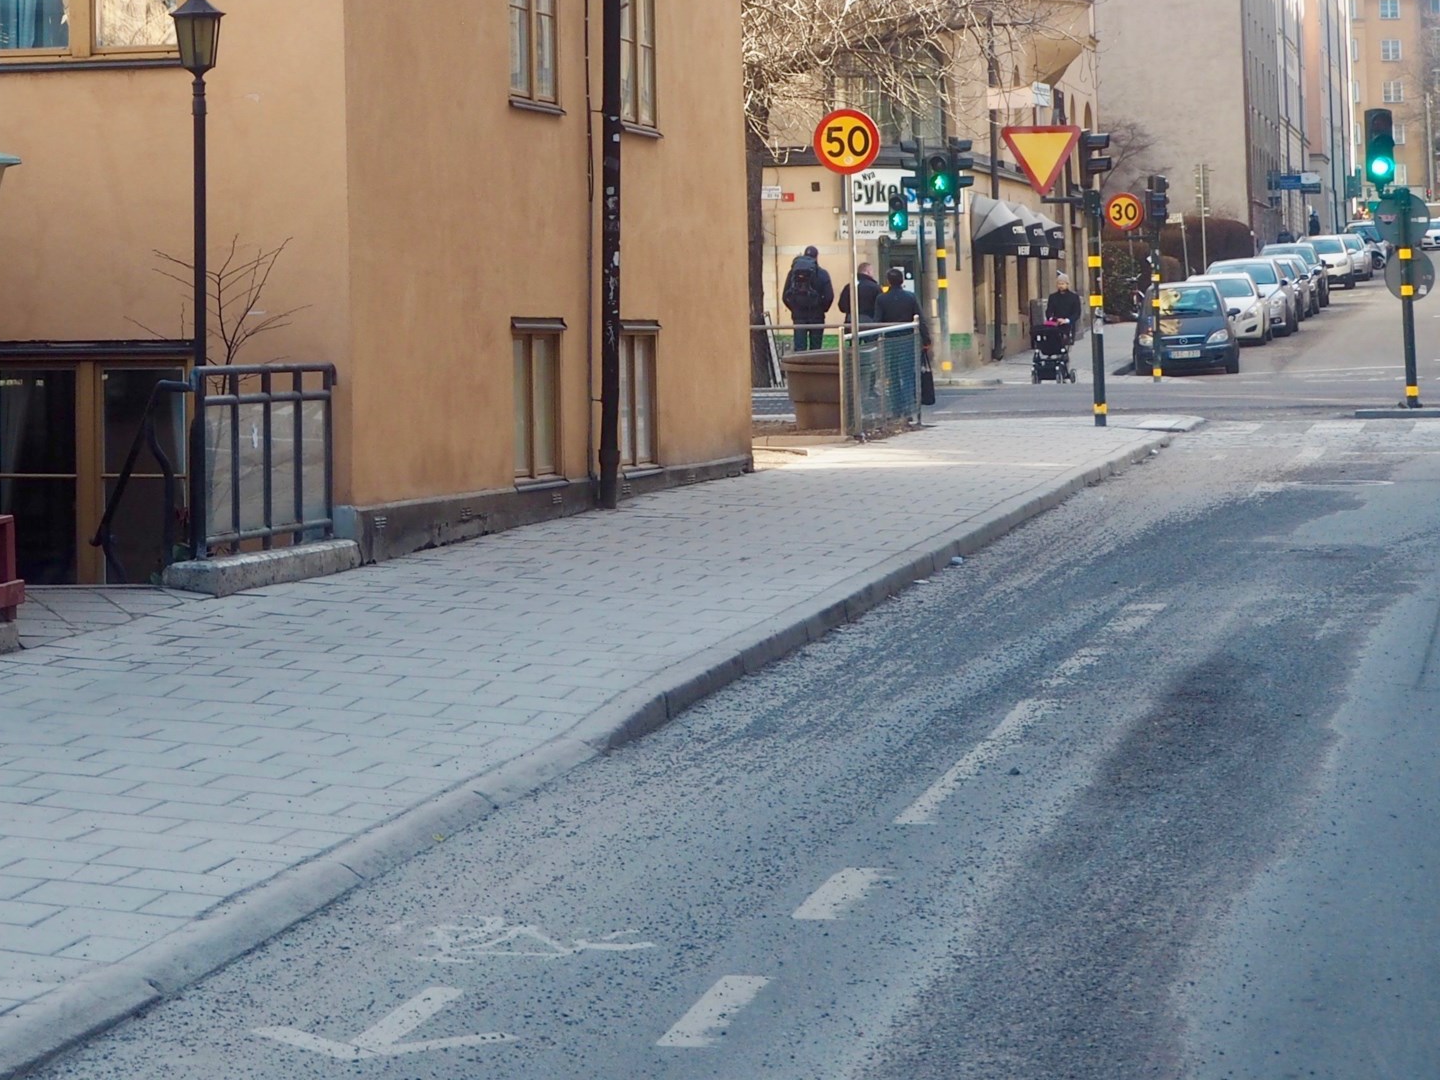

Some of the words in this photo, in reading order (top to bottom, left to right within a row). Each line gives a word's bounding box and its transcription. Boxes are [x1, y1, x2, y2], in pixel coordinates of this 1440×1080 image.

[826, 125, 869, 157] 50
[861, 170, 876, 182] Nya
[1112, 203, 1137, 222] 30
